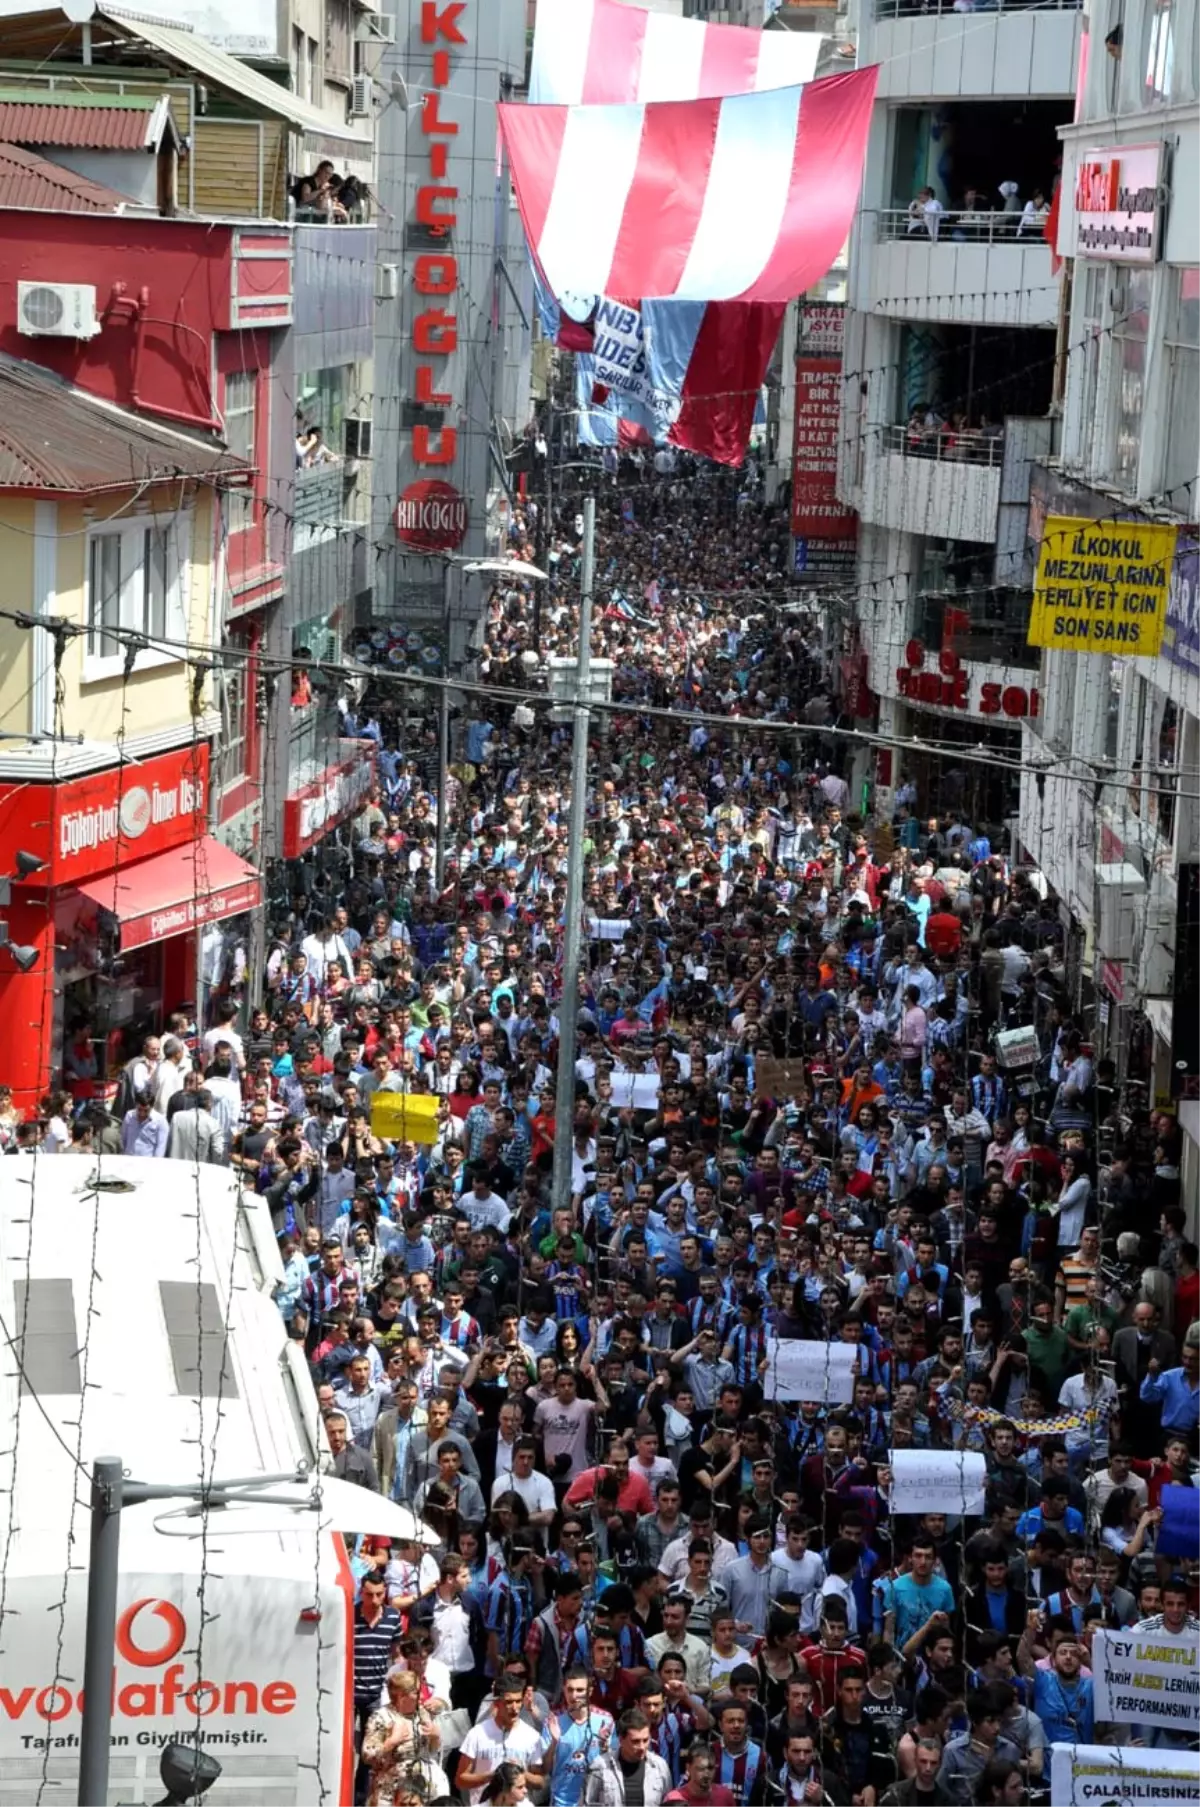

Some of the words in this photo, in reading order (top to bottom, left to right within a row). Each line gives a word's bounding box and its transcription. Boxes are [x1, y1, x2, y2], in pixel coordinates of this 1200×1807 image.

[801, 404, 820, 413] JET
[808, 431, 830, 443] KAT
[1044, 559, 1166, 587] MEZUNLARINA
[1054, 616, 1090, 638] SON
[152, 781, 177, 824] Ömer
[1114, 1642, 1133, 1657] EY
[21, 1733, 129, 1750] Tarafıan
